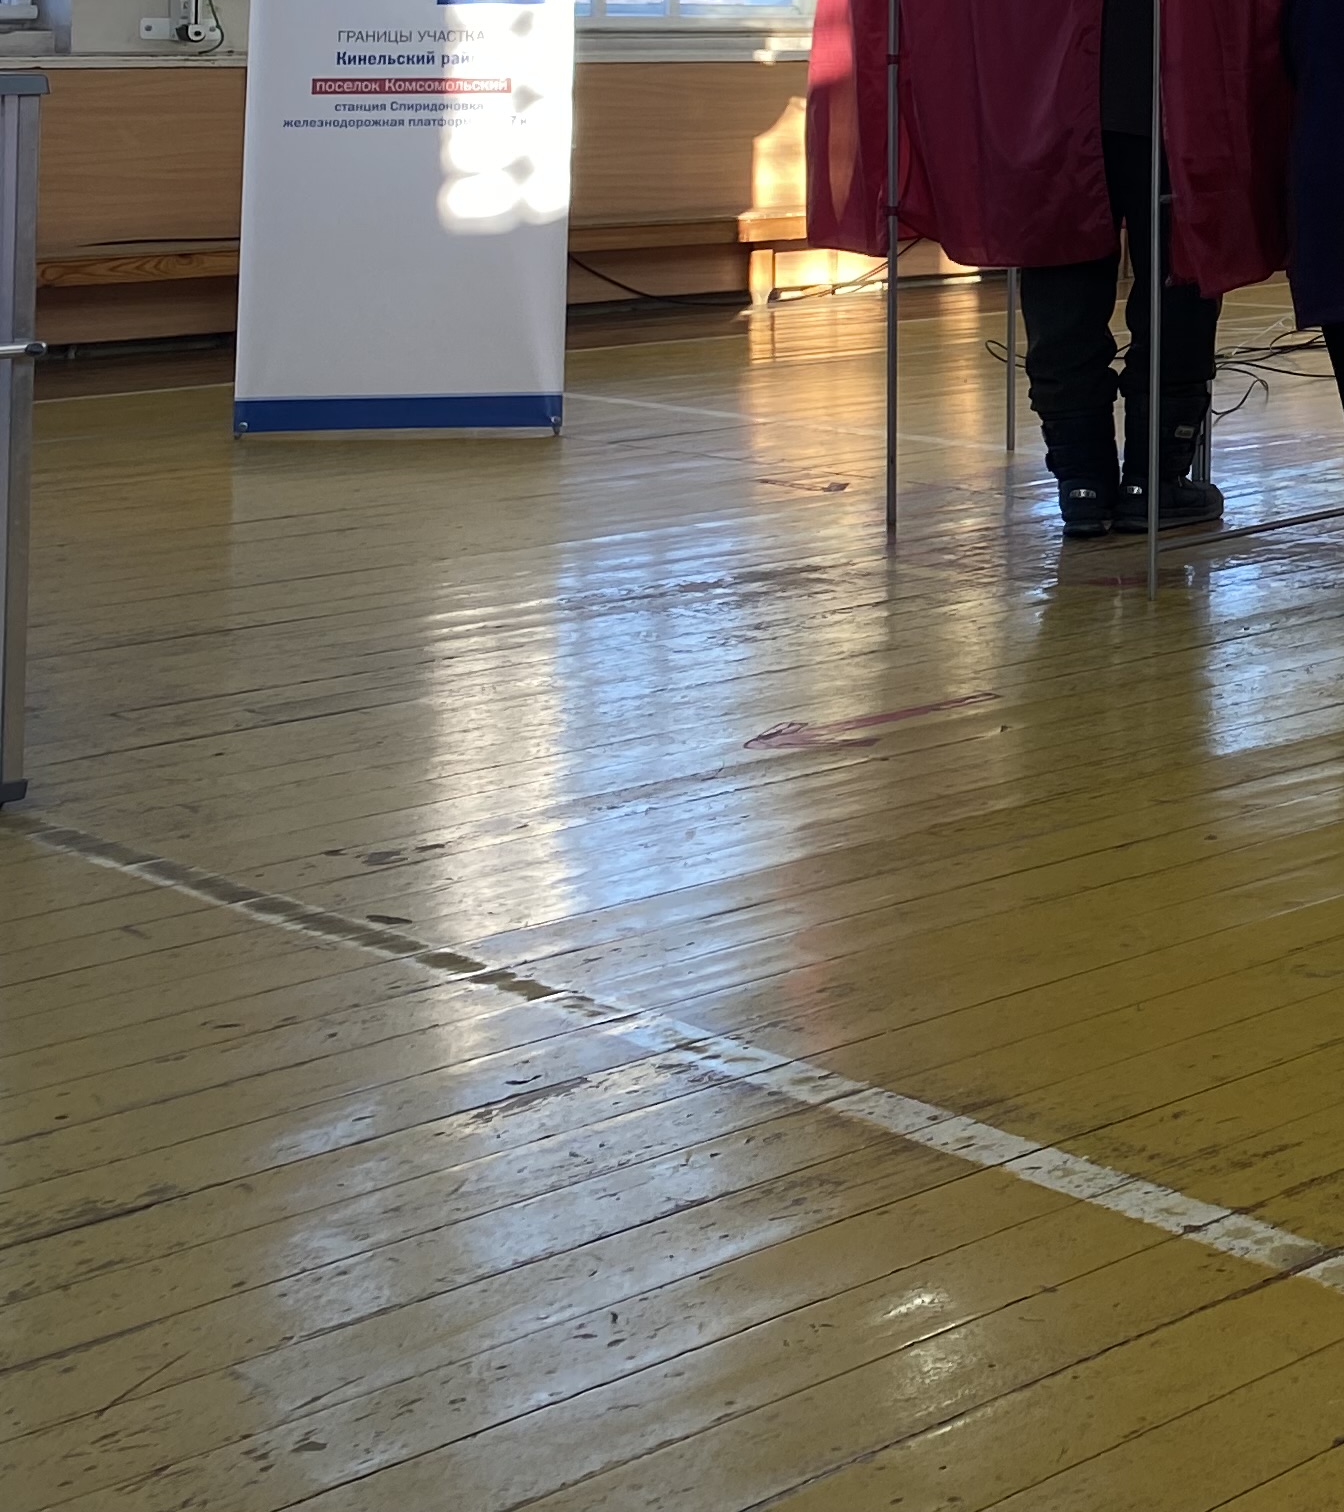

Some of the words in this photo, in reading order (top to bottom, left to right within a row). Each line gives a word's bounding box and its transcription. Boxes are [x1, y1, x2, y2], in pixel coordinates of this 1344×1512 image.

[338, 30, 413, 44] ГРАНИЦЫ
[336, 51, 435, 65] Кинельский
[316, 81, 380, 91] поселок
[384, 78, 508, 92] Комсомольский
[334, 103, 387, 113] станция
[390, 101, 484, 113] Спиридоновка
[282, 119, 405, 129] железнодорожная
